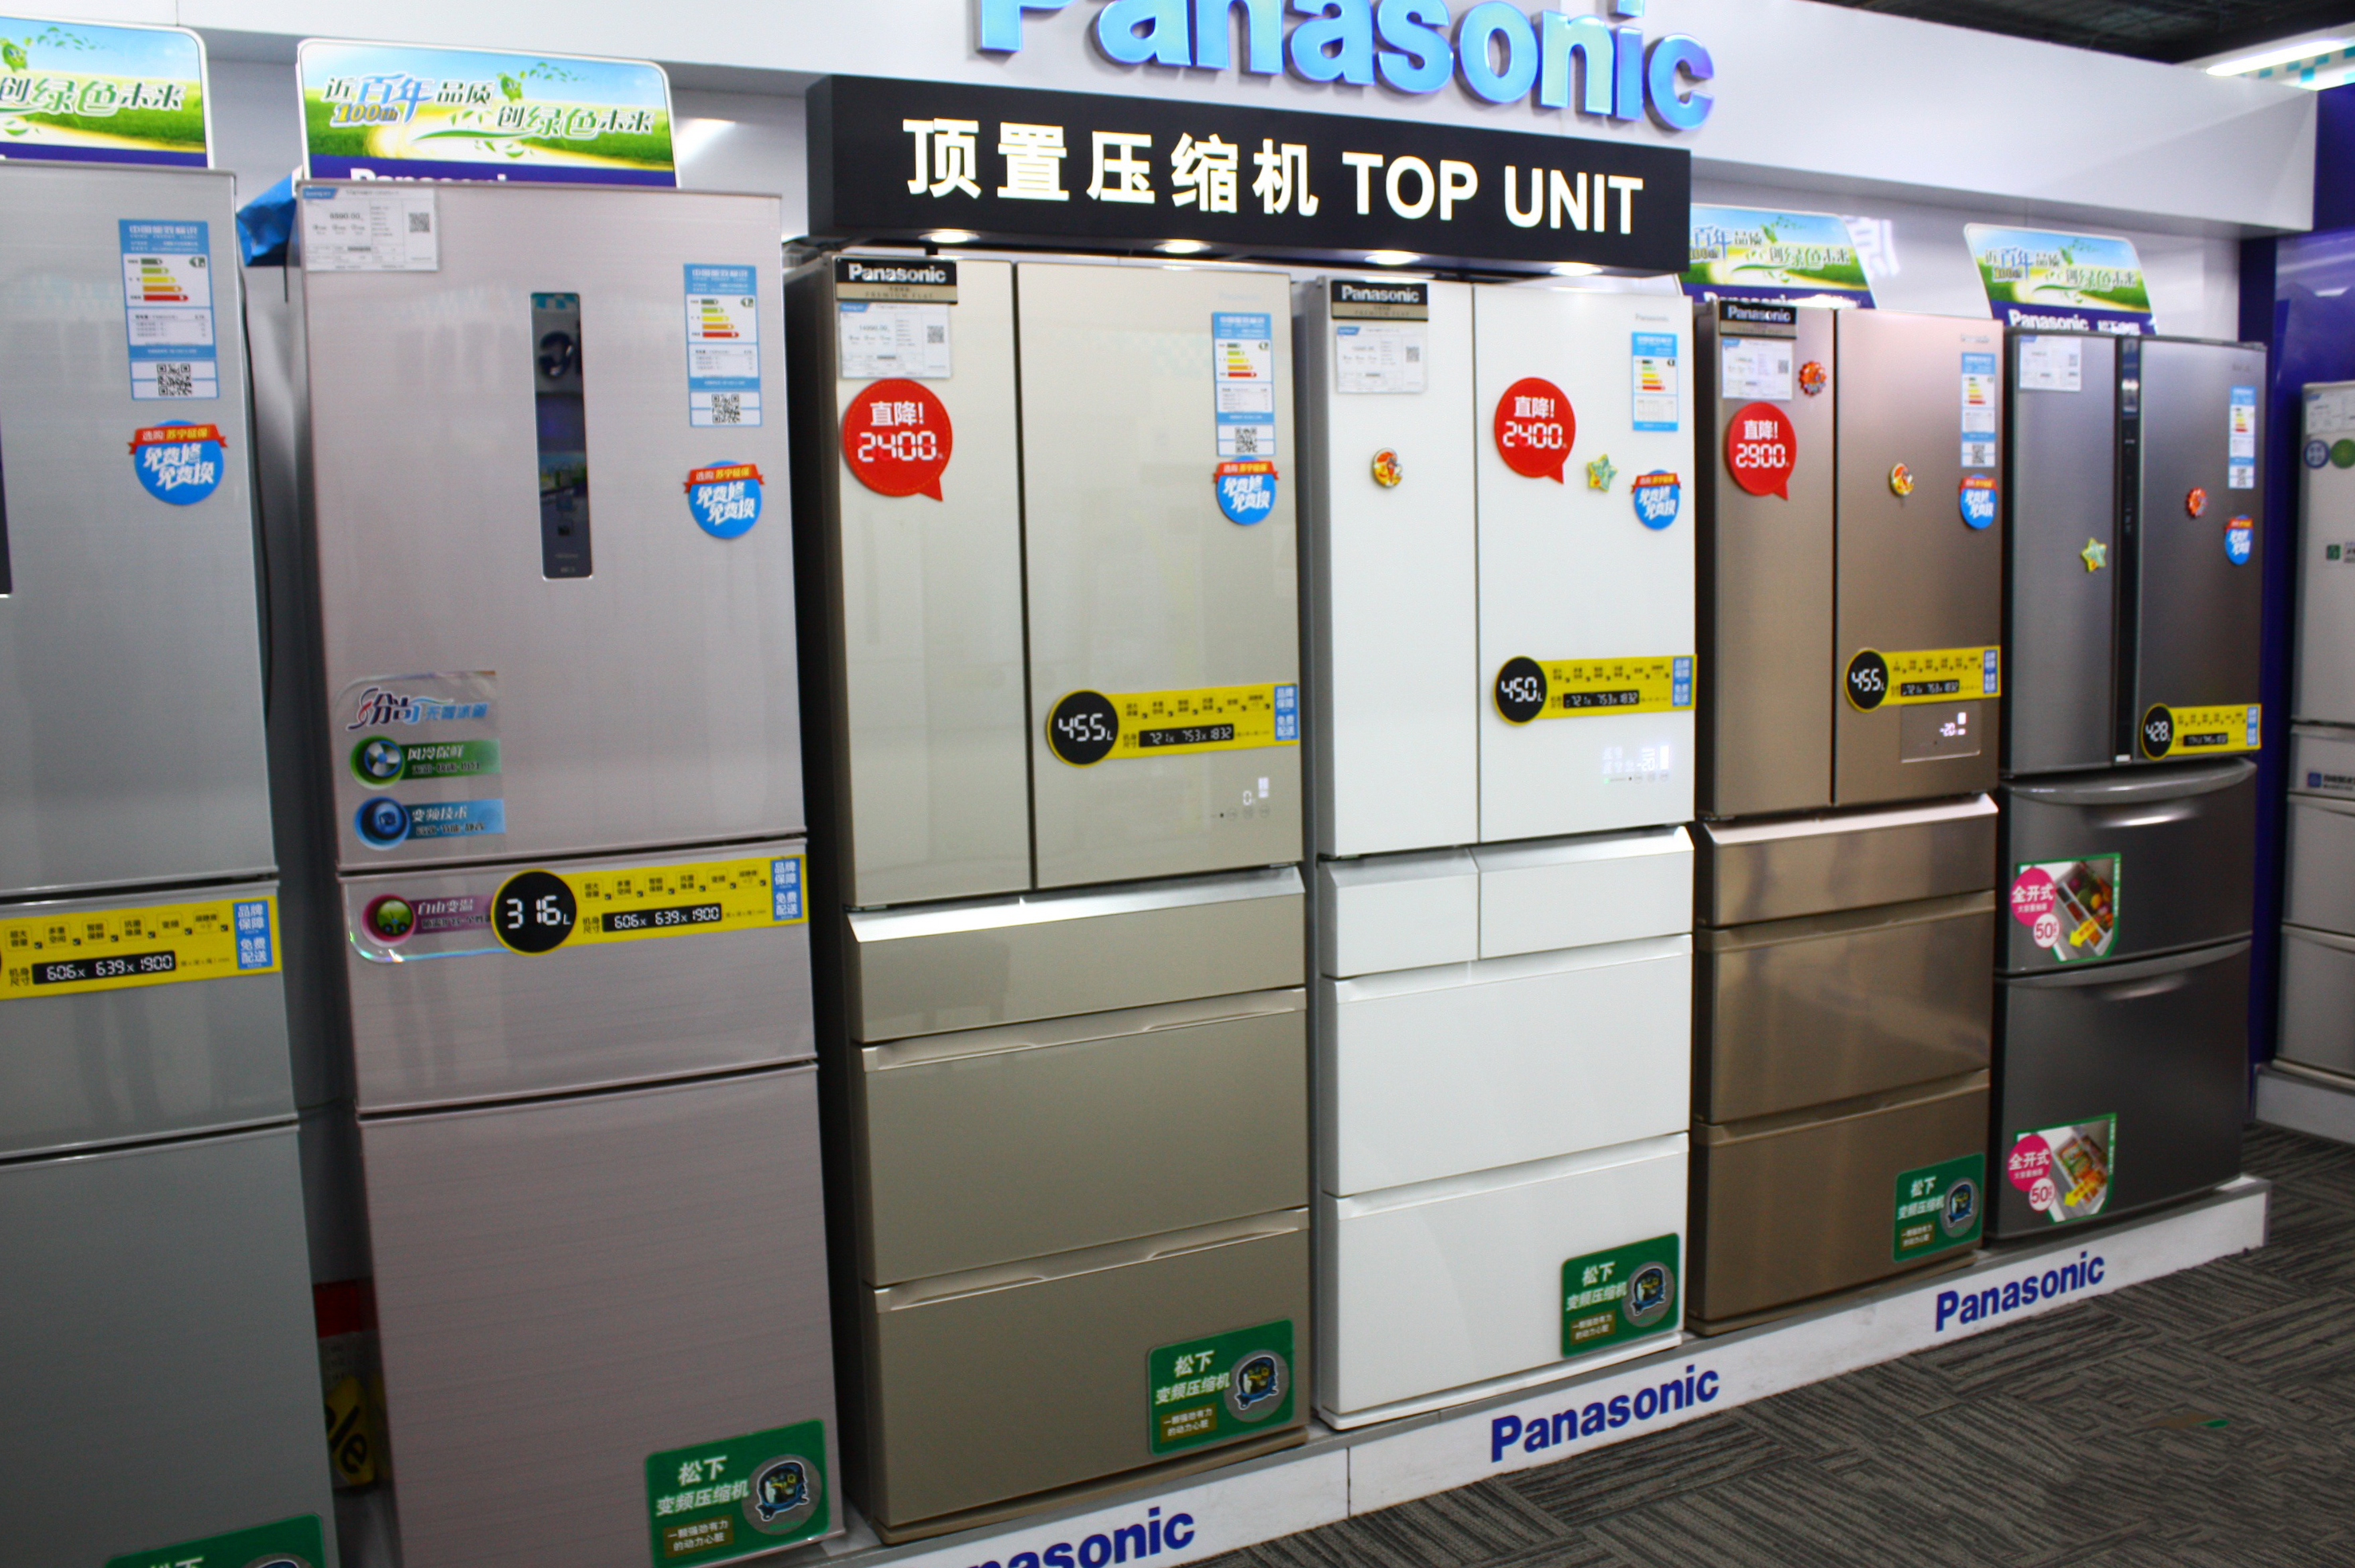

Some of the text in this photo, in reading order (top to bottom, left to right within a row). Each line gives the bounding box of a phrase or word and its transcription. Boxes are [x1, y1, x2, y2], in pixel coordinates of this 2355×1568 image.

[323, 72, 495, 123] 近百年品质
[331, 102, 400, 125] 100th
[497, 104, 656, 140] 创绿色未来
[902, 117, 1644, 234] 顶置压缩机 TOP UNIT
[848, 262, 947, 284] Panasonic
[1341, 283, 1420, 303] Panasonic
[1728, 304, 1791, 323] Panasonic
[870, 402, 924, 426] 直降!
[1514, 395, 1555, 419] 直降!
[1503, 421, 1563, 449] 2400
[1744, 420, 1779, 441] 直降!
[857, 430, 937, 462] 2400
[1736, 443, 1786, 468] 2900
[412, 806, 469, 823] 变频技术
[2011, 882, 2055, 903] 全开式
[238, 904, 263, 917] 品牌
[692, 906, 719, 922] 1900
[238, 916, 265, 929] 保障
[2035, 922, 2054, 940] 50
[241, 937, 265, 950] 免费
[141, 955, 173, 972] 1900
[242, 949, 268, 963] 配送
[9, 968, 29, 977] 机身
[10, 977, 30, 987] 尺寸
[2008, 1149, 2050, 1170] 全开式
[2030, 1186, 2048, 1204] 50
[1936, 1251, 2105, 1333] Panasonic
[1174, 1350, 1215, 1378] 松下
[1155, 1371, 1232, 1405] 变频压缩机
[1492, 1364, 1720, 1464] Panasonic
[678, 1455, 727, 1487] 松下
[655, 1479, 750, 1517] 变频压缩机
[966, 1506, 1194, 1568] sonic
